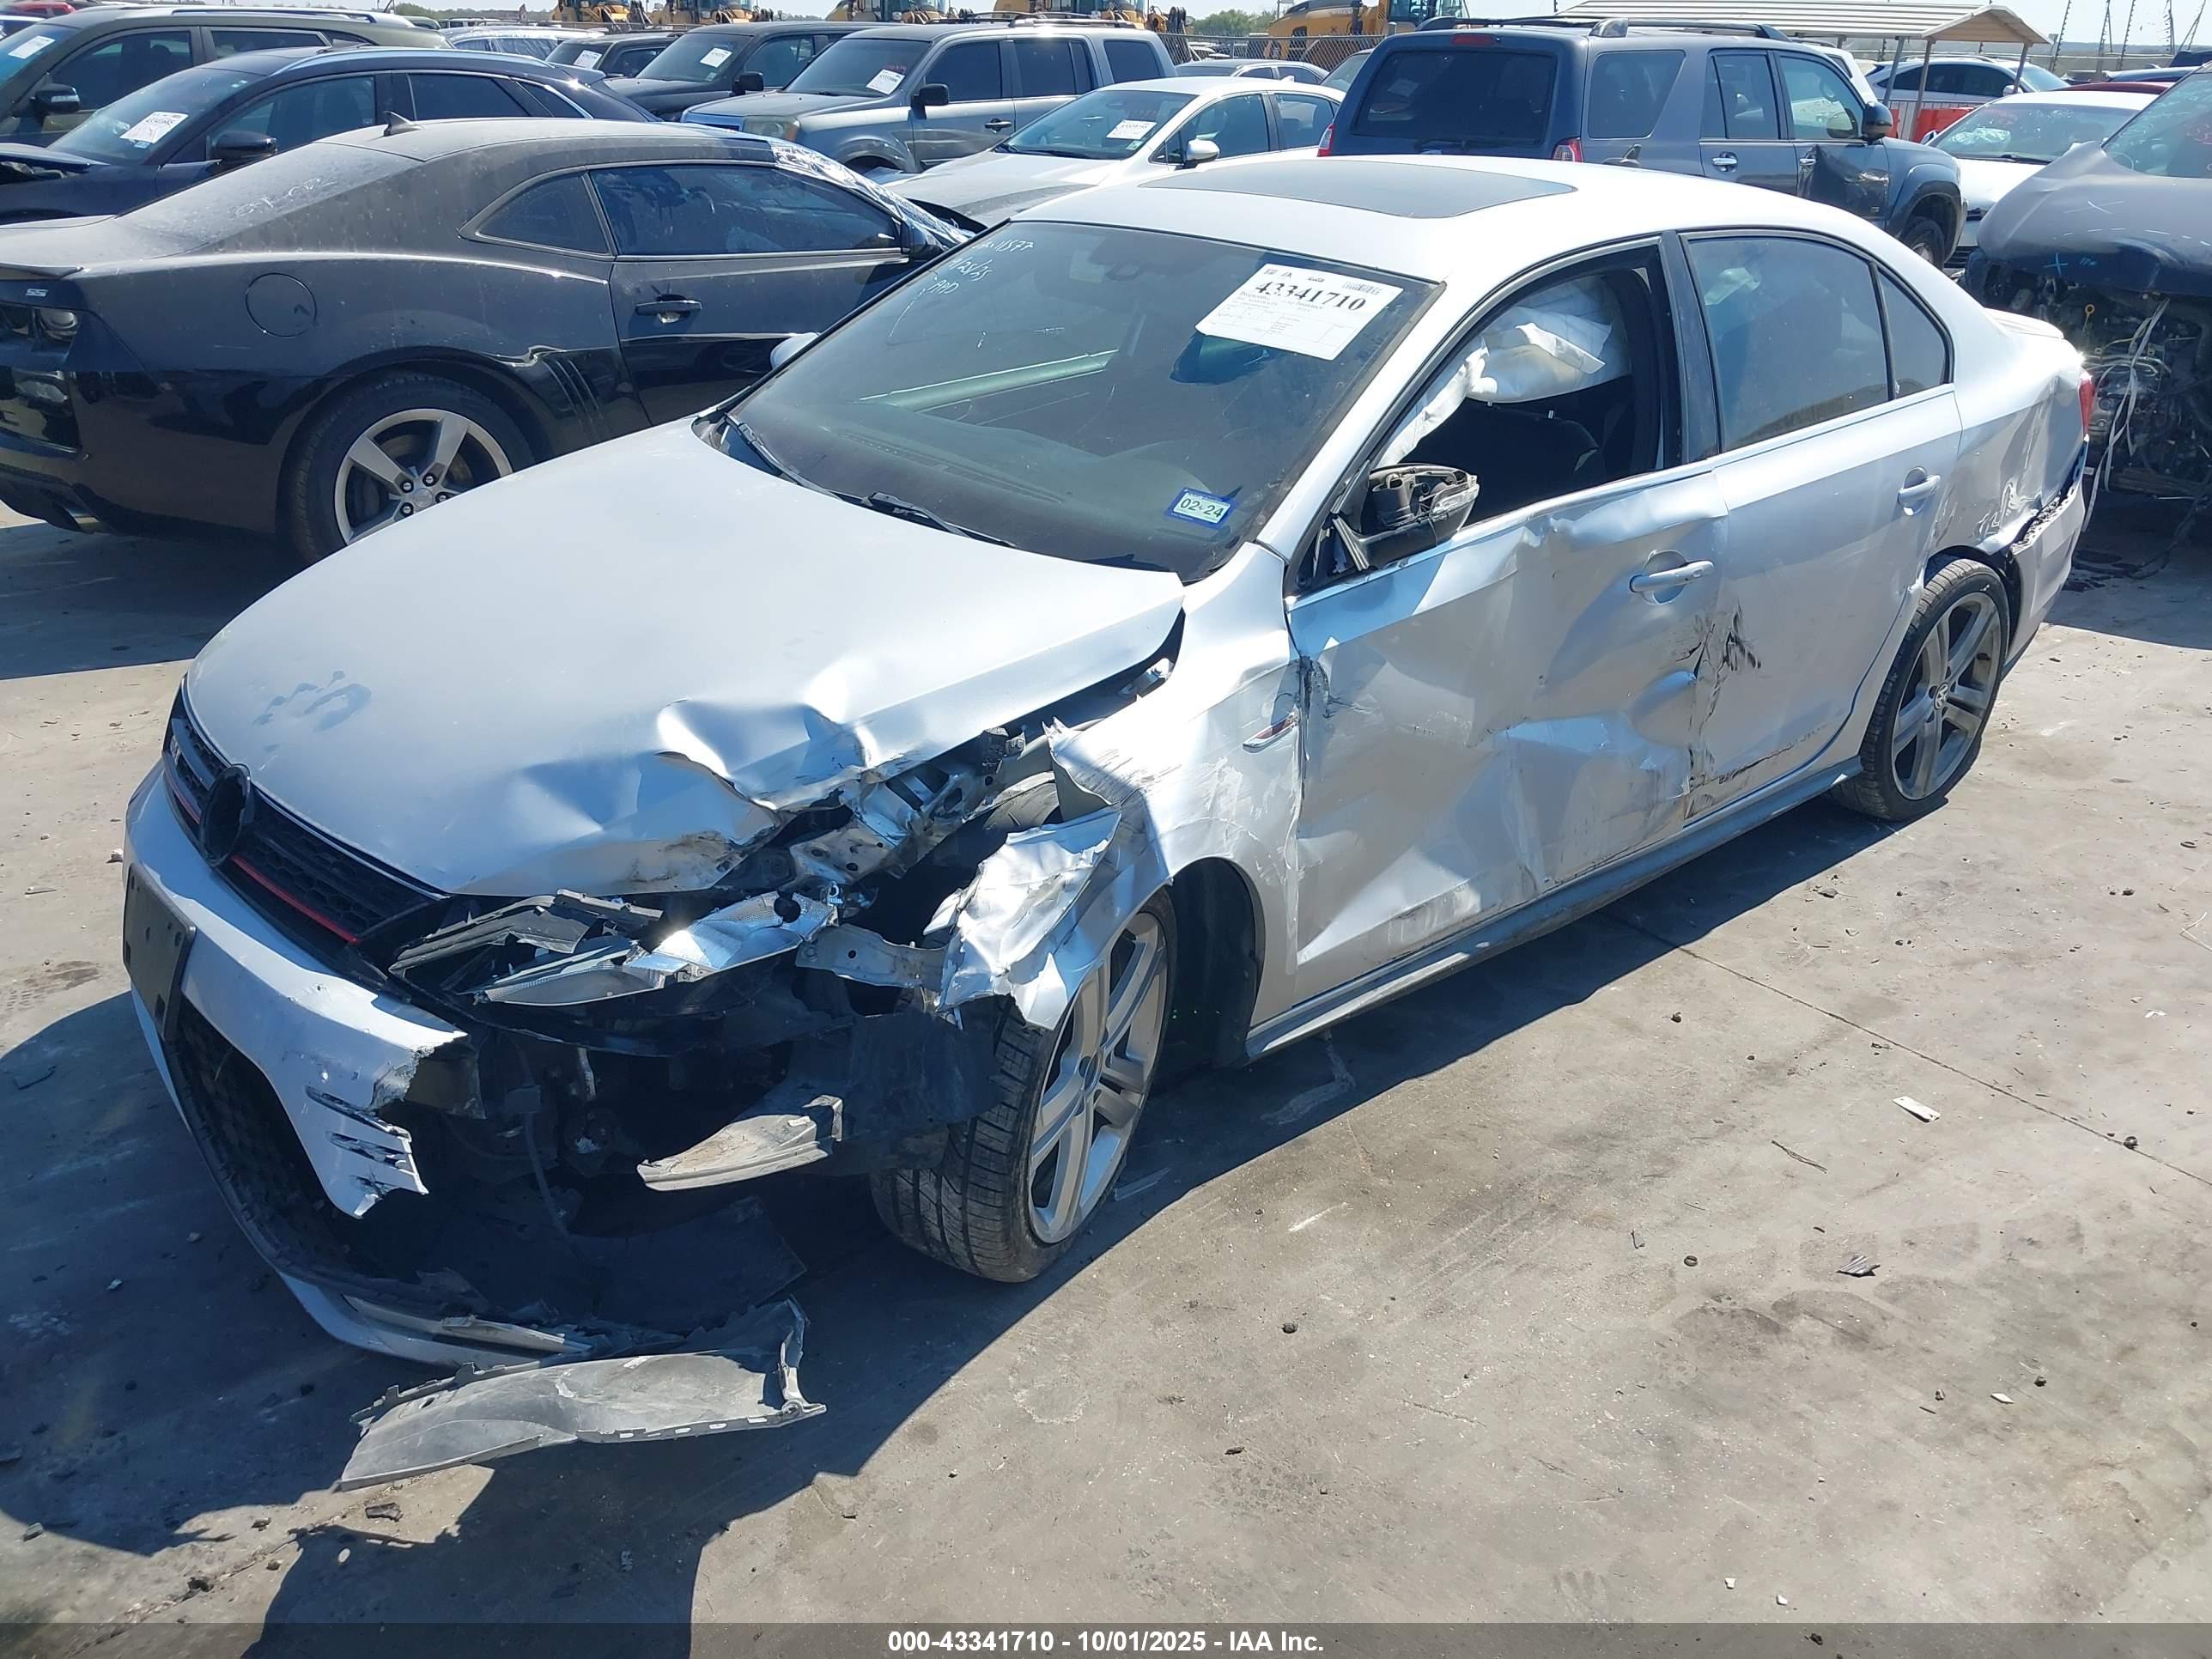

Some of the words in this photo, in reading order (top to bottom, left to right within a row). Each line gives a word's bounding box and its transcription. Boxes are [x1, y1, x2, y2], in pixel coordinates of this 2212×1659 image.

[25, 288, 49, 297] SS
[1255, 281, 1366, 311] 43341710
[1180, 498, 1200, 511] 02
[1203, 505, 1224, 518] 24
